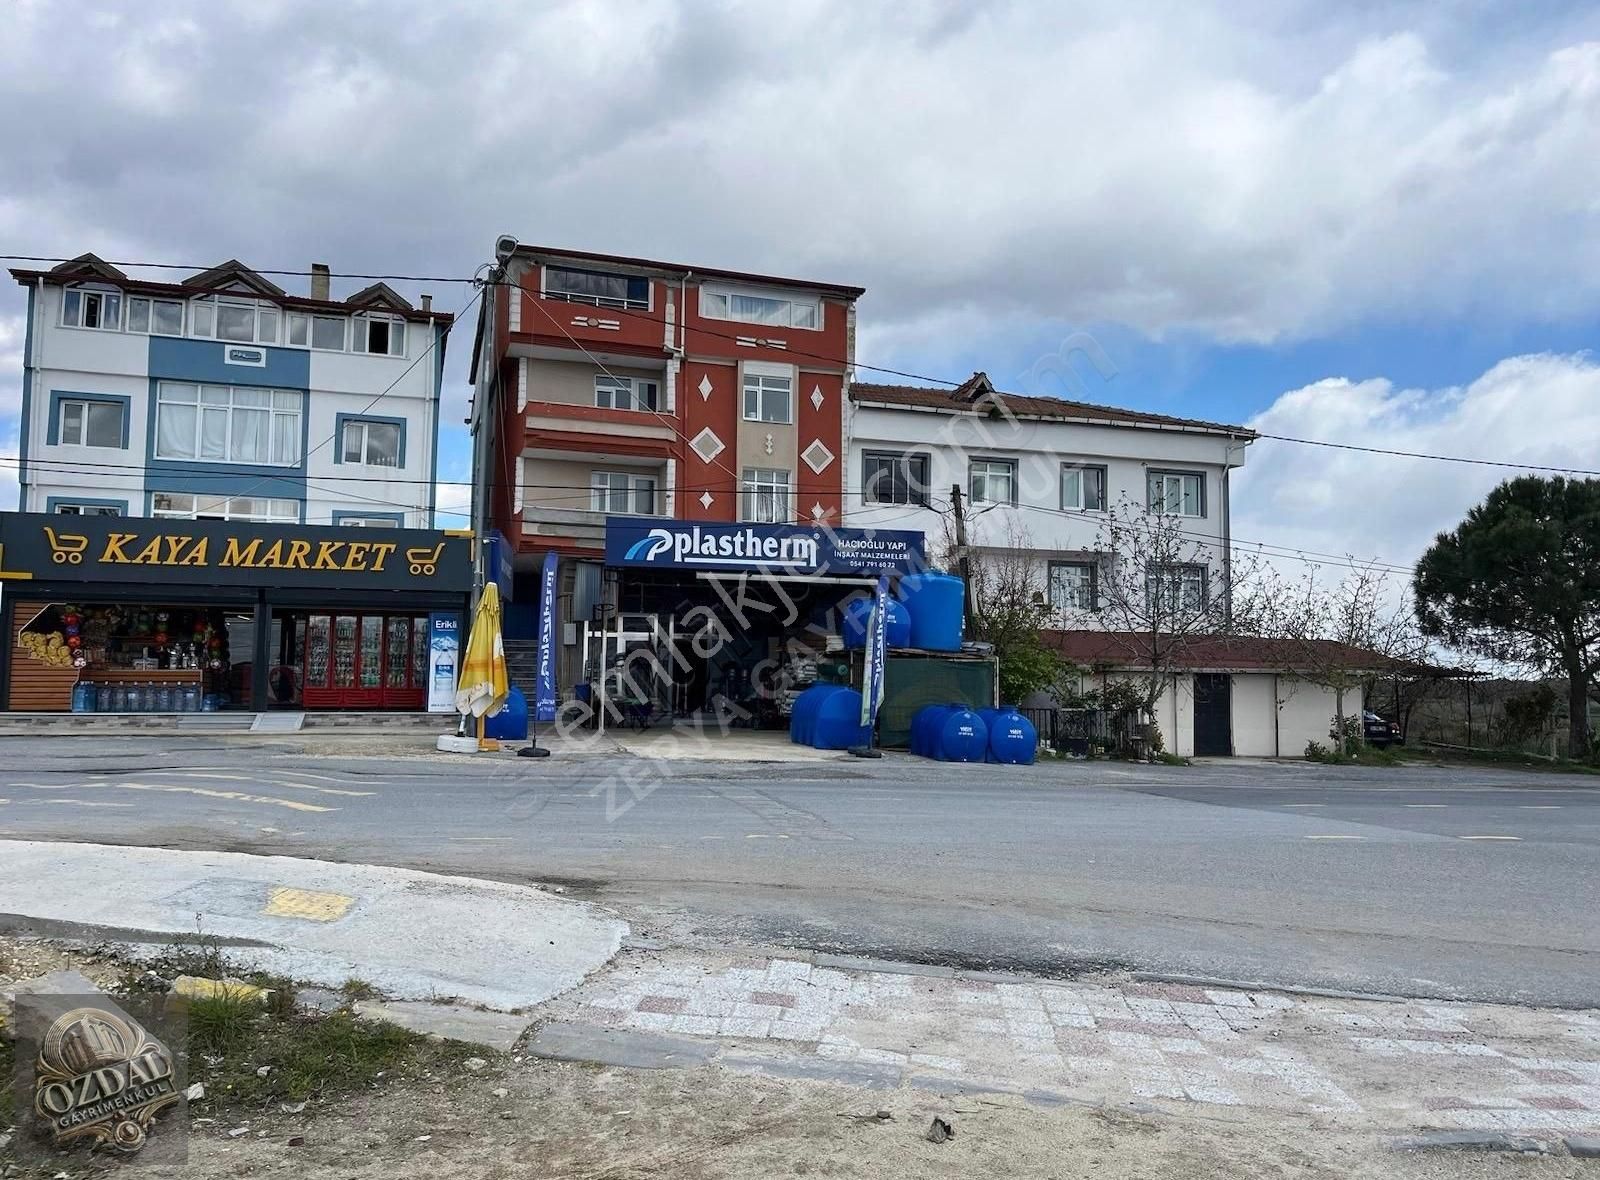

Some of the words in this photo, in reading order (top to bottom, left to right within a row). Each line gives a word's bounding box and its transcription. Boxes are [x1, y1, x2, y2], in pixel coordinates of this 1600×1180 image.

[838, 538, 885, 550] HACIOĞLU
[887, 541, 907, 550] YAPI
[98, 533, 209, 567] KAYA
[218, 536, 397, 572] MARKET
[834, 550, 860, 559] İNŞAAT
[861, 552, 911, 560] MALZEMELERİ
[435, 620, 457, 629] Erikli
